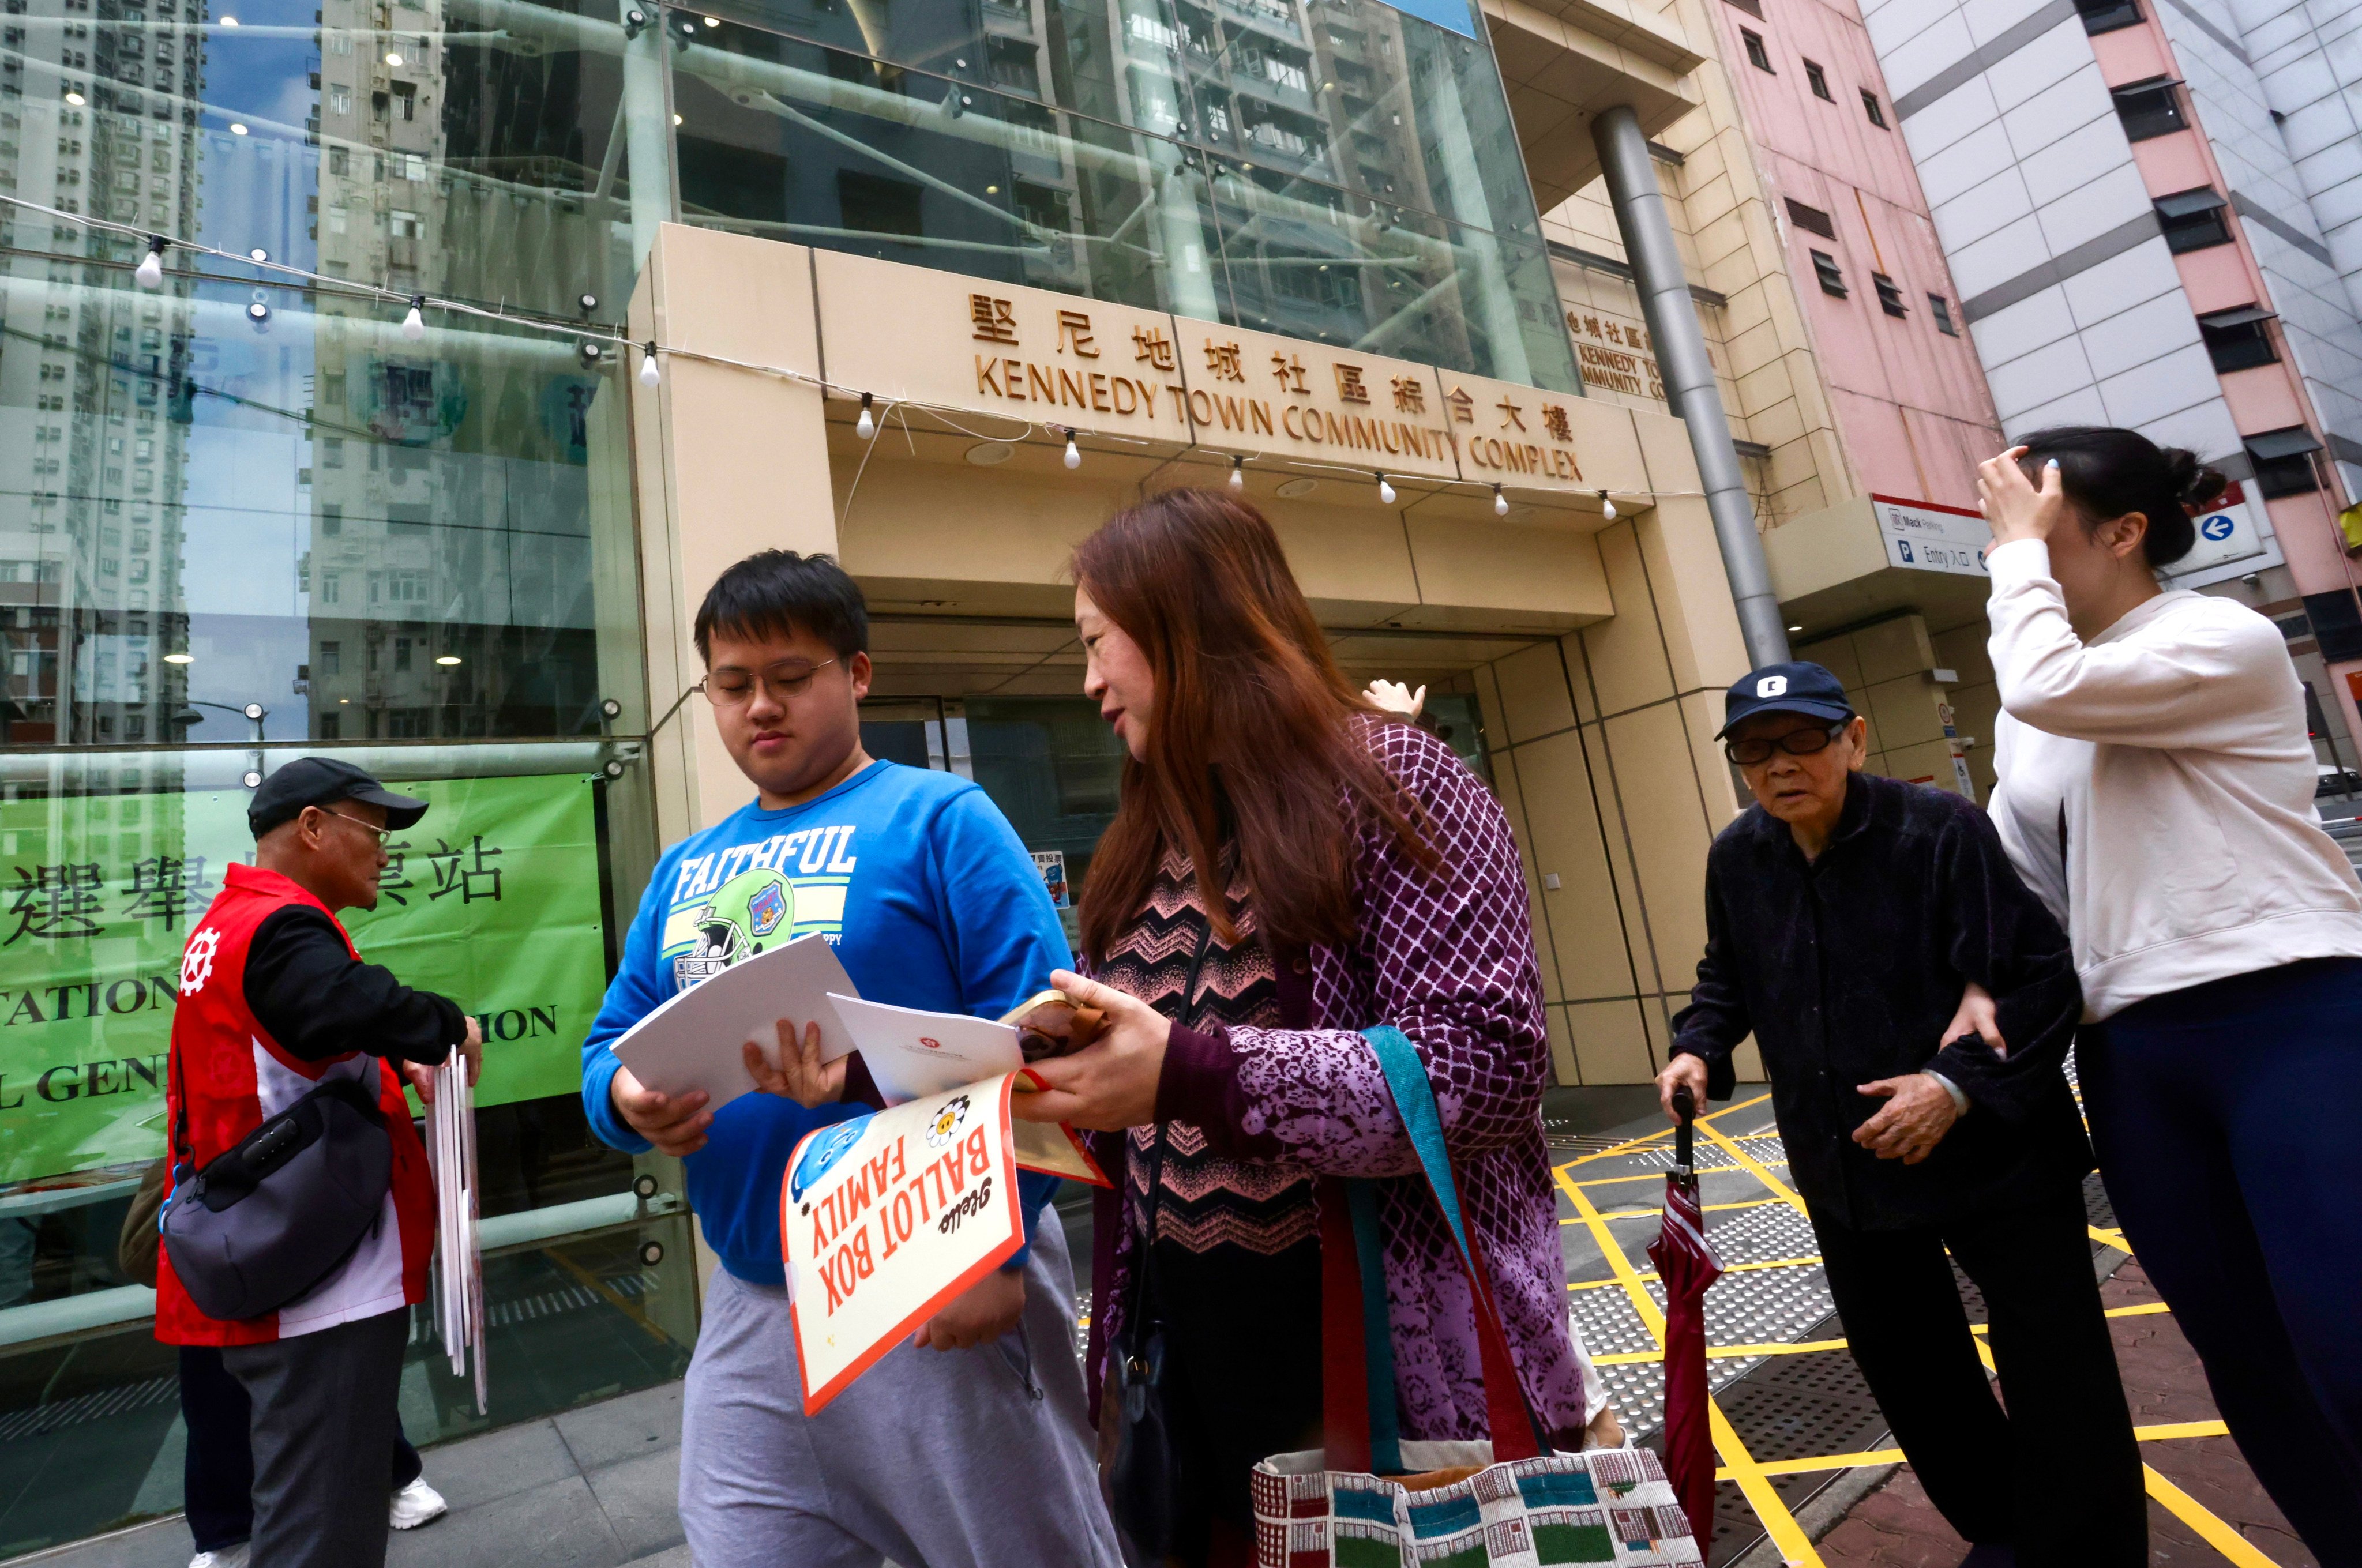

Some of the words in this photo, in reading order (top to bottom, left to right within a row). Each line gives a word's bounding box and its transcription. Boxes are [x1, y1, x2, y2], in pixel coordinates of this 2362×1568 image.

[968, 293, 1574, 443] 堅尼地城社區綜合大樓
[1579, 344, 1637, 374] KENNEDY
[1642, 359, 1661, 379] TO
[1581, 364, 1642, 394] MMUNITY
[1648, 381, 1666, 400] CO
[975, 354, 1158, 419] KENNEDY
[1165, 385, 1274, 436] TOWN
[1282, 405, 1460, 461] COMMUNITY
[1469, 435, 1583, 482] COMPLEX
[1903, 515, 1922, 528] Mack
[1924, 546, 1948, 568] Entry
[1950, 550, 1970, 566] 入口
[671, 825, 857, 905] FAITHFUL
[0, 974, 178, 1026] ATION
[37, 1052, 169, 1102] GEN
[472, 1005, 558, 1044] ION
[812, 1134, 906, 1259] FAMILY
[880, 1123, 990, 1261] BALLOT
[938, 1176, 992, 1234] Hello
[818, 1224, 874, 1318] BOX
